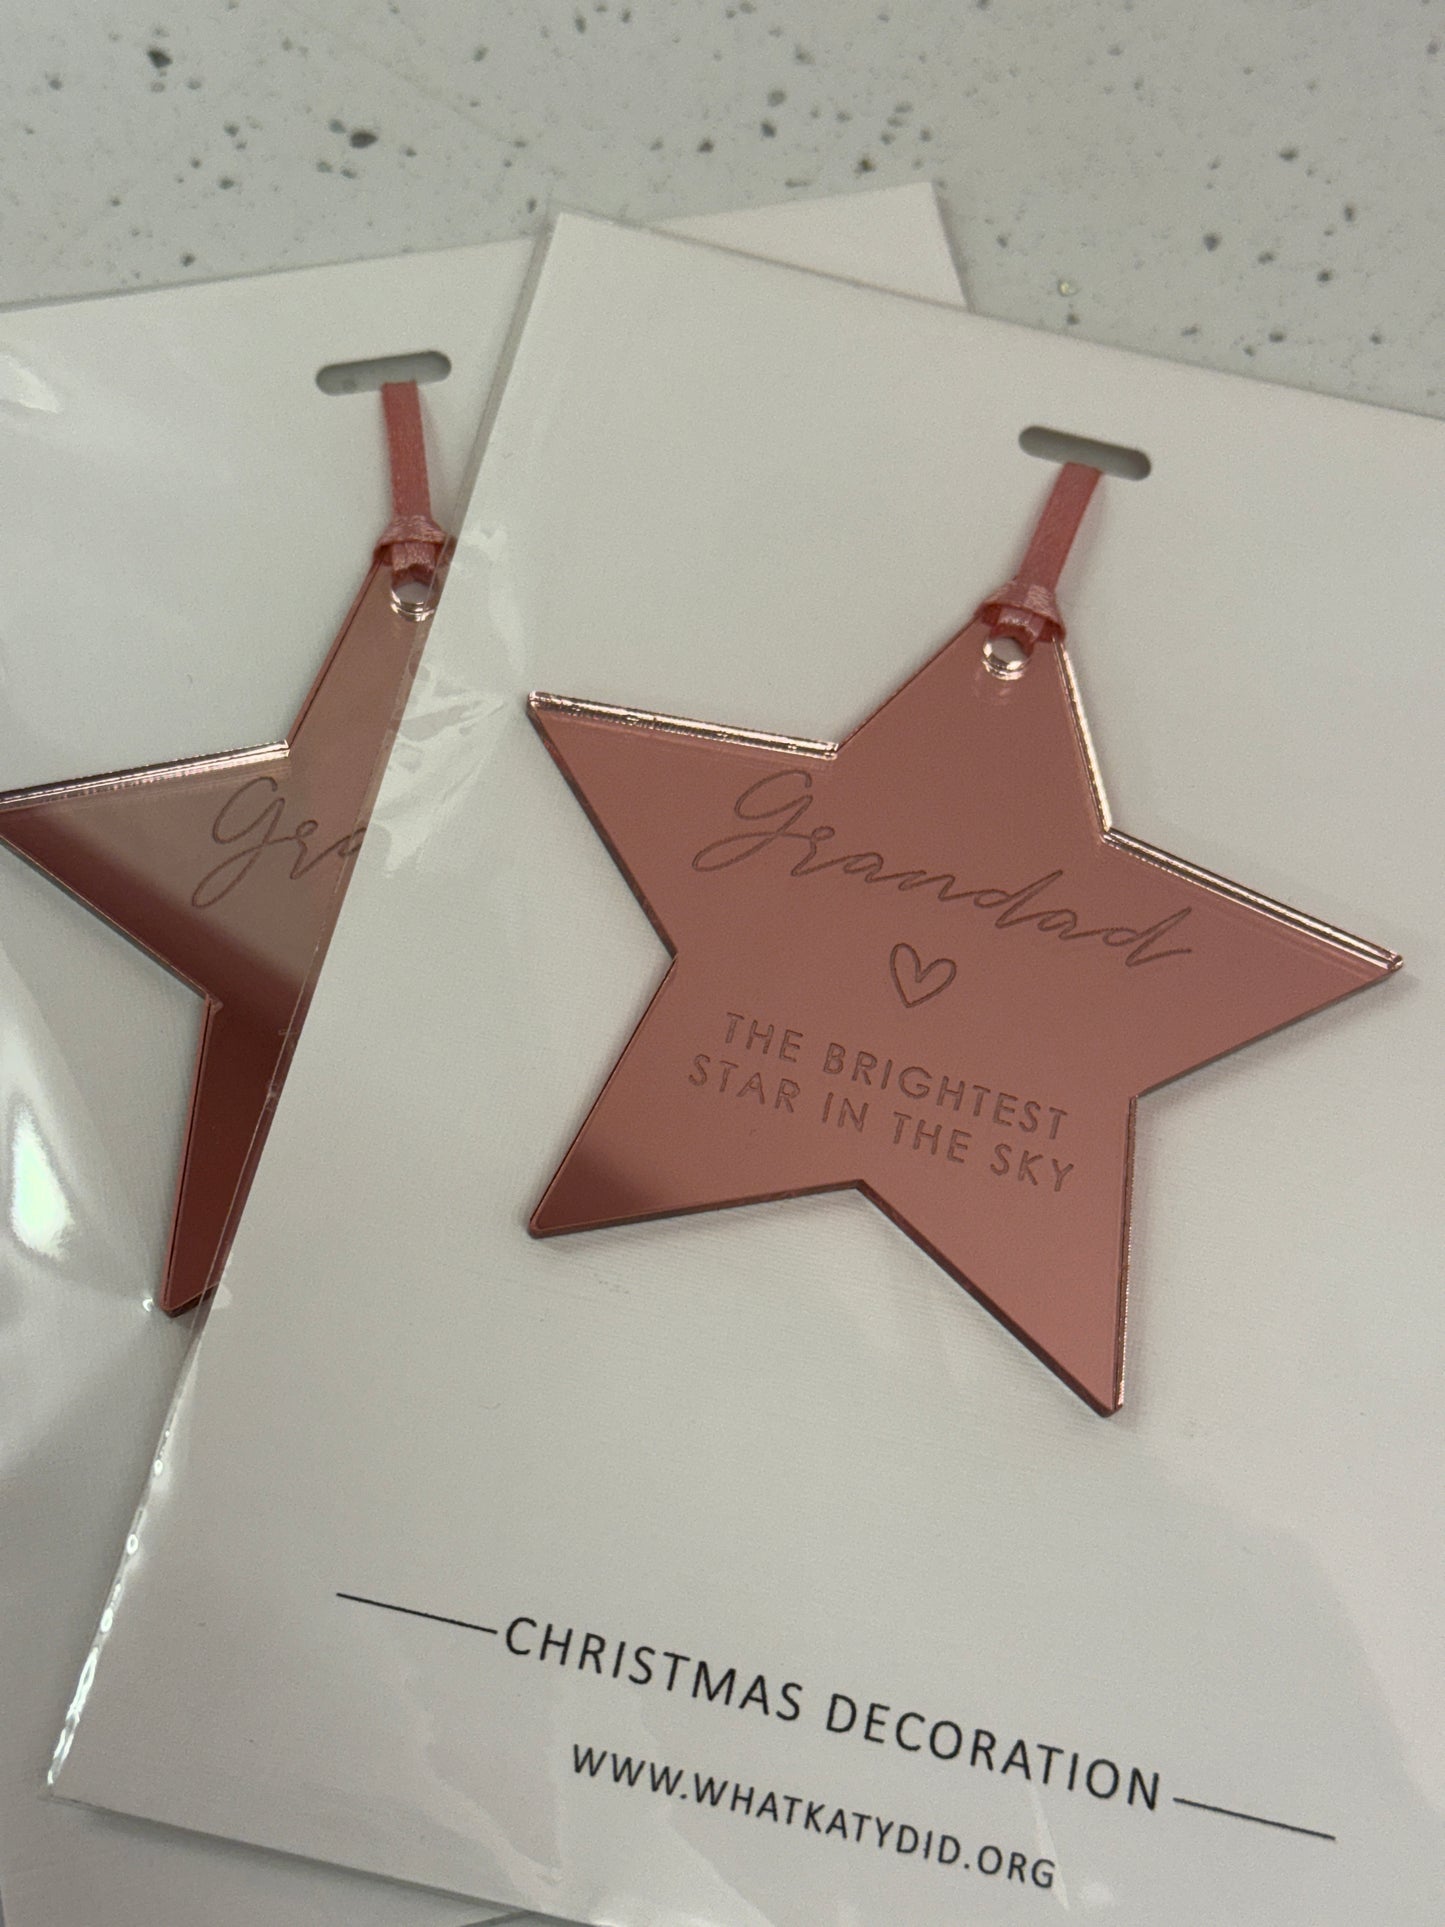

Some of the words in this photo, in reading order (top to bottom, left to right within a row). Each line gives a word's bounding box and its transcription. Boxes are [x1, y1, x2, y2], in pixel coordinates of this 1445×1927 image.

[691, 769, 1192, 966] Grandad
[688, 1053, 801, 1114] STAR
[822, 1092, 869, 1132] IN
[892, 1111, 973, 1165] THE
[990, 1143, 1075, 1192] SKY
[726, 1012, 804, 1063] THE
[822, 1042, 1068, 1140] BRIGHTEST
[505, 1615, 804, 1723] CHRISTMAS
[825, 1692, 1161, 1811] DECORATION
[571, 1742, 1058, 1889] WWW.WHATKATYDID.ORG
